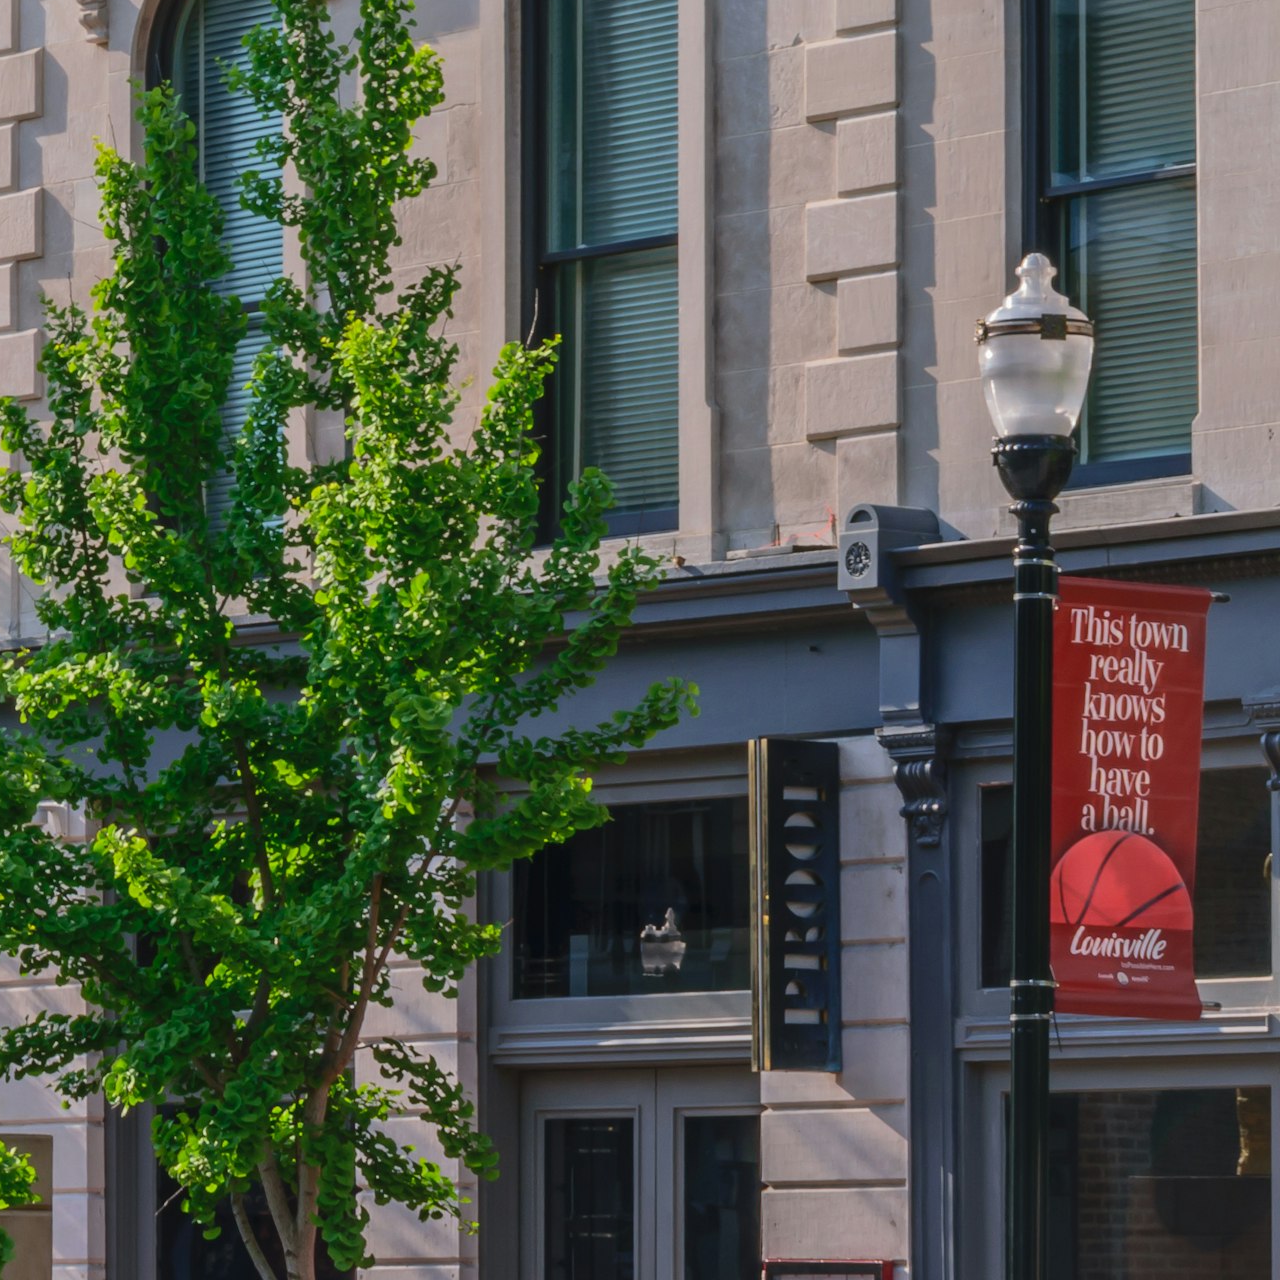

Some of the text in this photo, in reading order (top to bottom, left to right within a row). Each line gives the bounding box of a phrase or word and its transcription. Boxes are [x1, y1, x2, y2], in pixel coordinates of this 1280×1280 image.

[1071, 606, 1190, 653] This town
[1088, 648, 1165, 695] really
[1082, 682, 1167, 725] knows
[1079, 718, 1164, 761] how to
[1088, 754, 1151, 797] have
[1081, 794, 1155, 835] a ball.
[1070, 925, 1167, 960] Louisville
